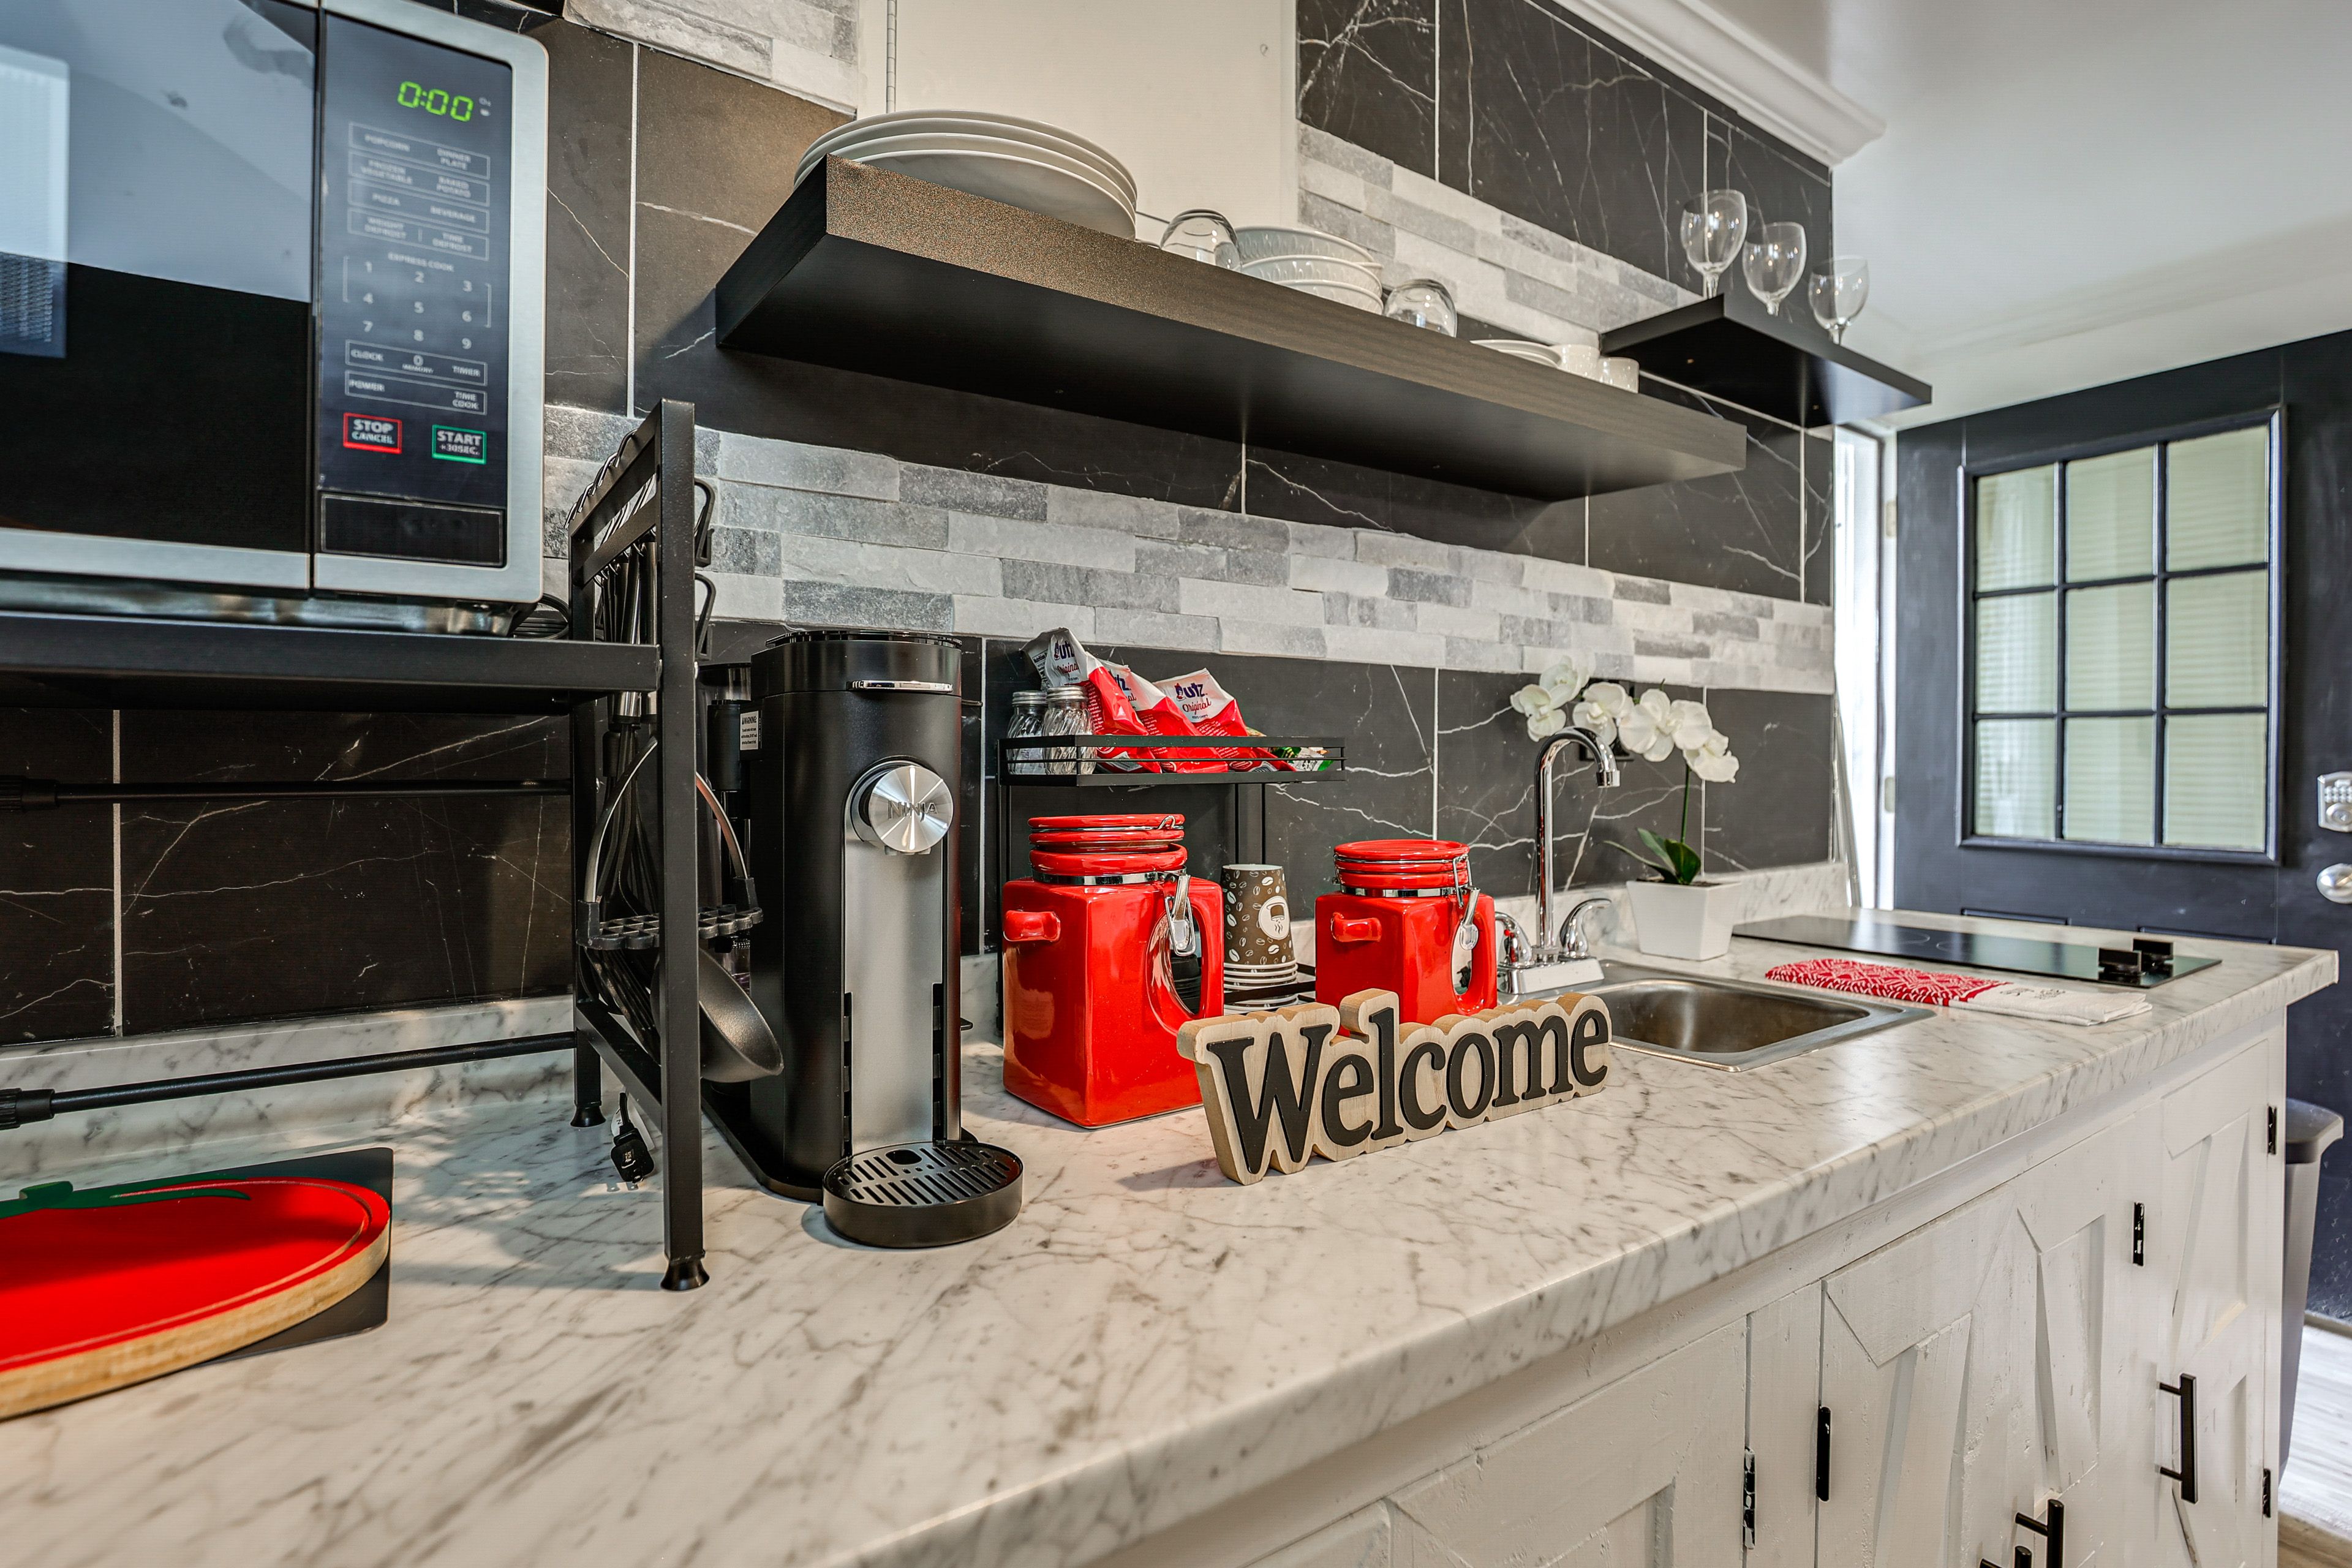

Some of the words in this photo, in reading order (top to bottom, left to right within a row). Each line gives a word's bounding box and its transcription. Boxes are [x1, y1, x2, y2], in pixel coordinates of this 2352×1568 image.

[398, 81, 474, 122] 0:00
[364, 134, 410, 152] POPCORN
[372, 192, 401, 206] PIZZA
[430, 205, 475, 223] BEVERAGE
[365, 260, 372, 273] 1
[415, 271, 424, 284] 2
[462, 280, 472, 292] 3
[363, 293, 374, 304] 4
[414, 301, 424, 314] 5
[462, 311, 472, 322] 6
[363, 320, 374, 332] 7
[413, 329, 424, 342] 8
[462, 337, 472, 350] 9
[350, 349, 384, 362] CLOCK
[413, 355, 424, 366] 0
[451, 365, 481, 377] TIMER
[349, 379, 385, 392] POWER
[454, 391, 477, 401] TIME
[452, 399, 479, 410] COOK
[353, 419, 394, 434] STOP
[352, 431, 395, 445] CANCEL
[437, 430, 483, 446] START
[1182, 698, 1212, 715] Original
[888, 799, 938, 822] NINJA
[1206, 1006, 1609, 1175] Welcome
